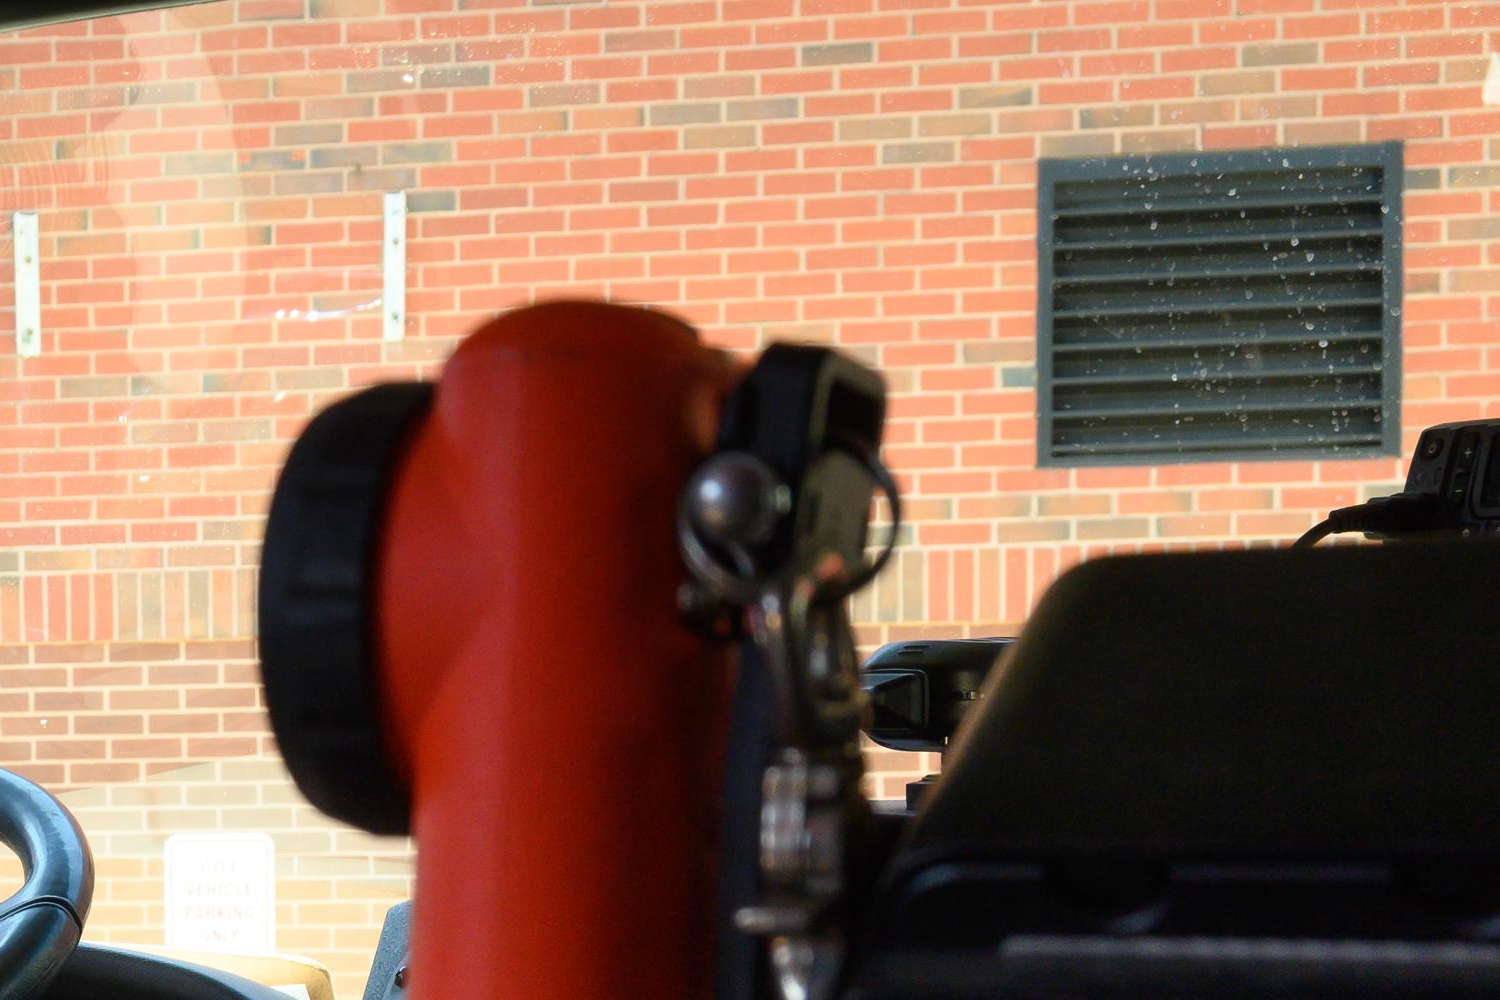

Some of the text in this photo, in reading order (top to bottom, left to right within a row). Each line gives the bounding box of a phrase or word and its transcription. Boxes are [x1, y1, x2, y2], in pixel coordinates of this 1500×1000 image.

[202, 859, 237, 873] CITY
[186, 881, 251, 897] VEHICLE
[185, 904, 254, 920] PARKING
[200, 928, 239, 942] ONLY
